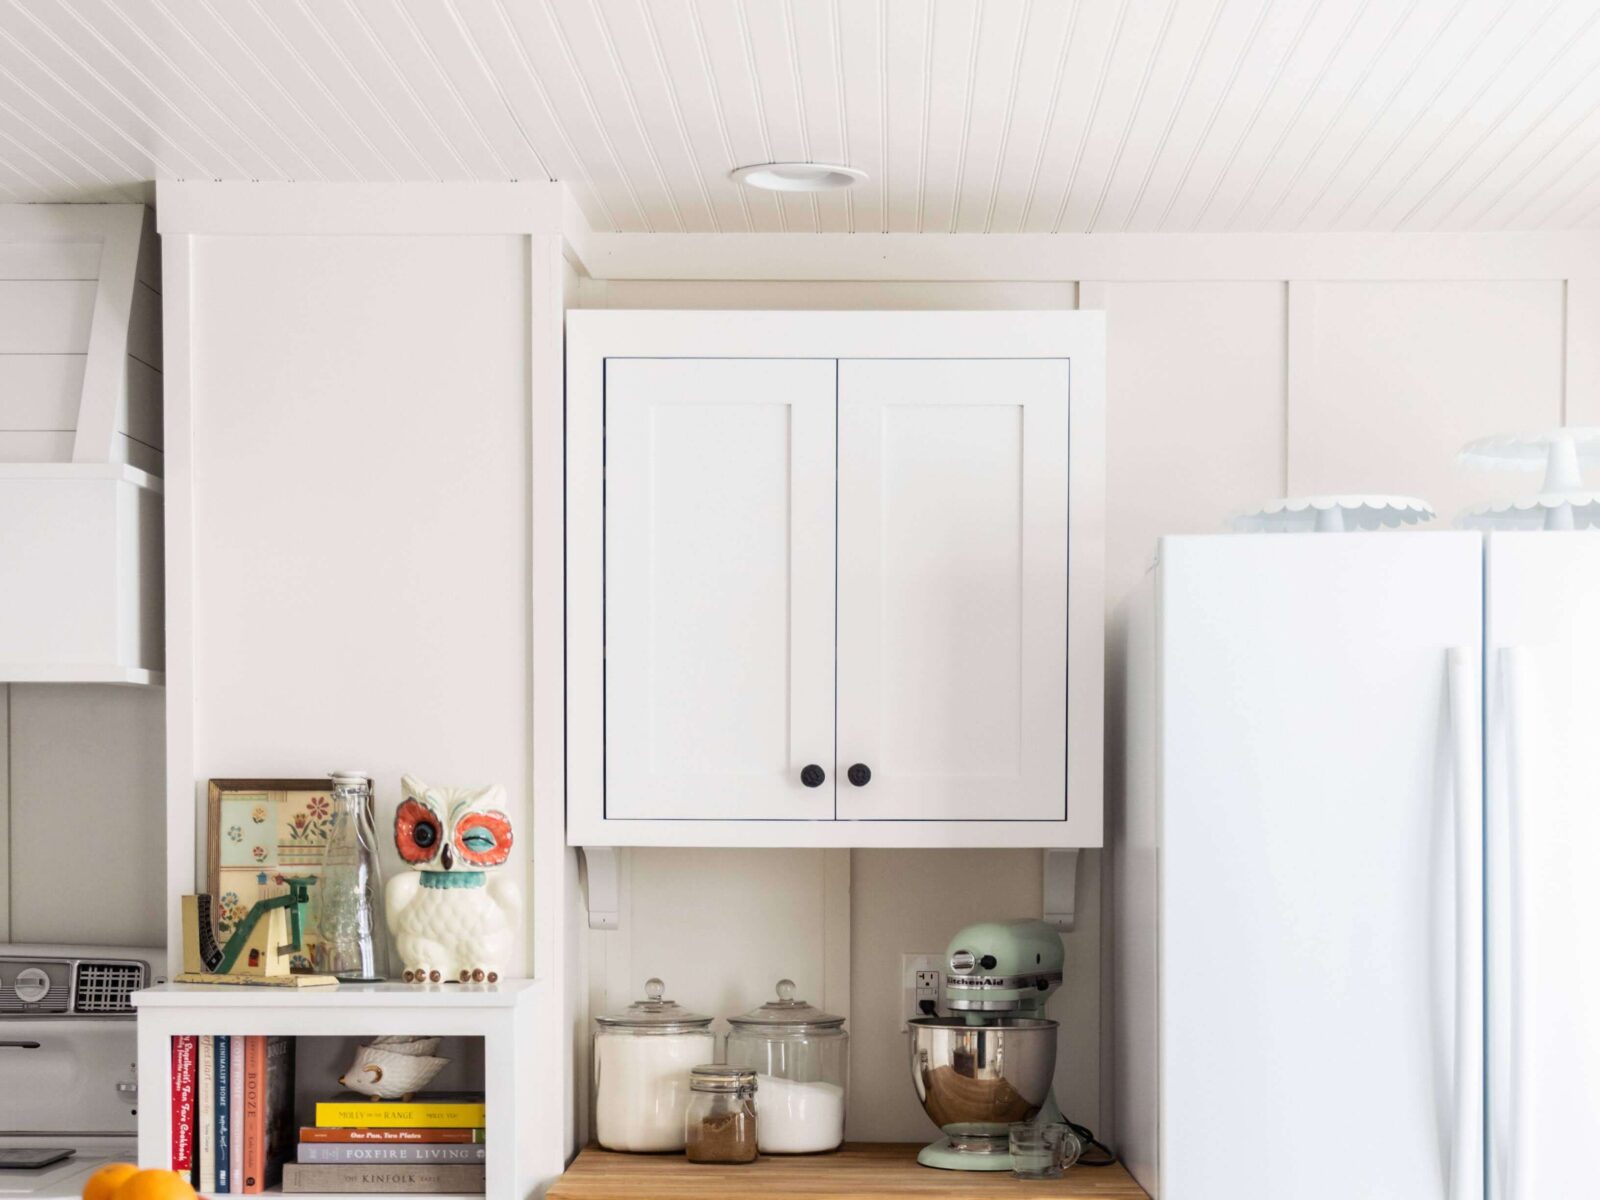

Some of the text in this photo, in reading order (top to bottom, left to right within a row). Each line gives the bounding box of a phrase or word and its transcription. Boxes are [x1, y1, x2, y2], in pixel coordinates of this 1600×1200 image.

[947, 978, 1004, 986] KitchenAid
[201, 1036, 213, 1058] erfect
[183, 1043, 193, 1084] Engelbreit's
[182, 1085, 191, 1101] Fan
[248, 1072, 256, 1118] BOOZE
[181, 1103, 190, 1121] Fare
[338, 1111, 364, 1119] MOLLY
[384, 1111, 413, 1119] RANGE
[179, 1124, 189, 1161] Cookbook
[346, 1150, 407, 1158] FOXFIRE
[416, 1150, 469, 1158] LIVING
[362, 1175, 416, 1183] KINFOLK
